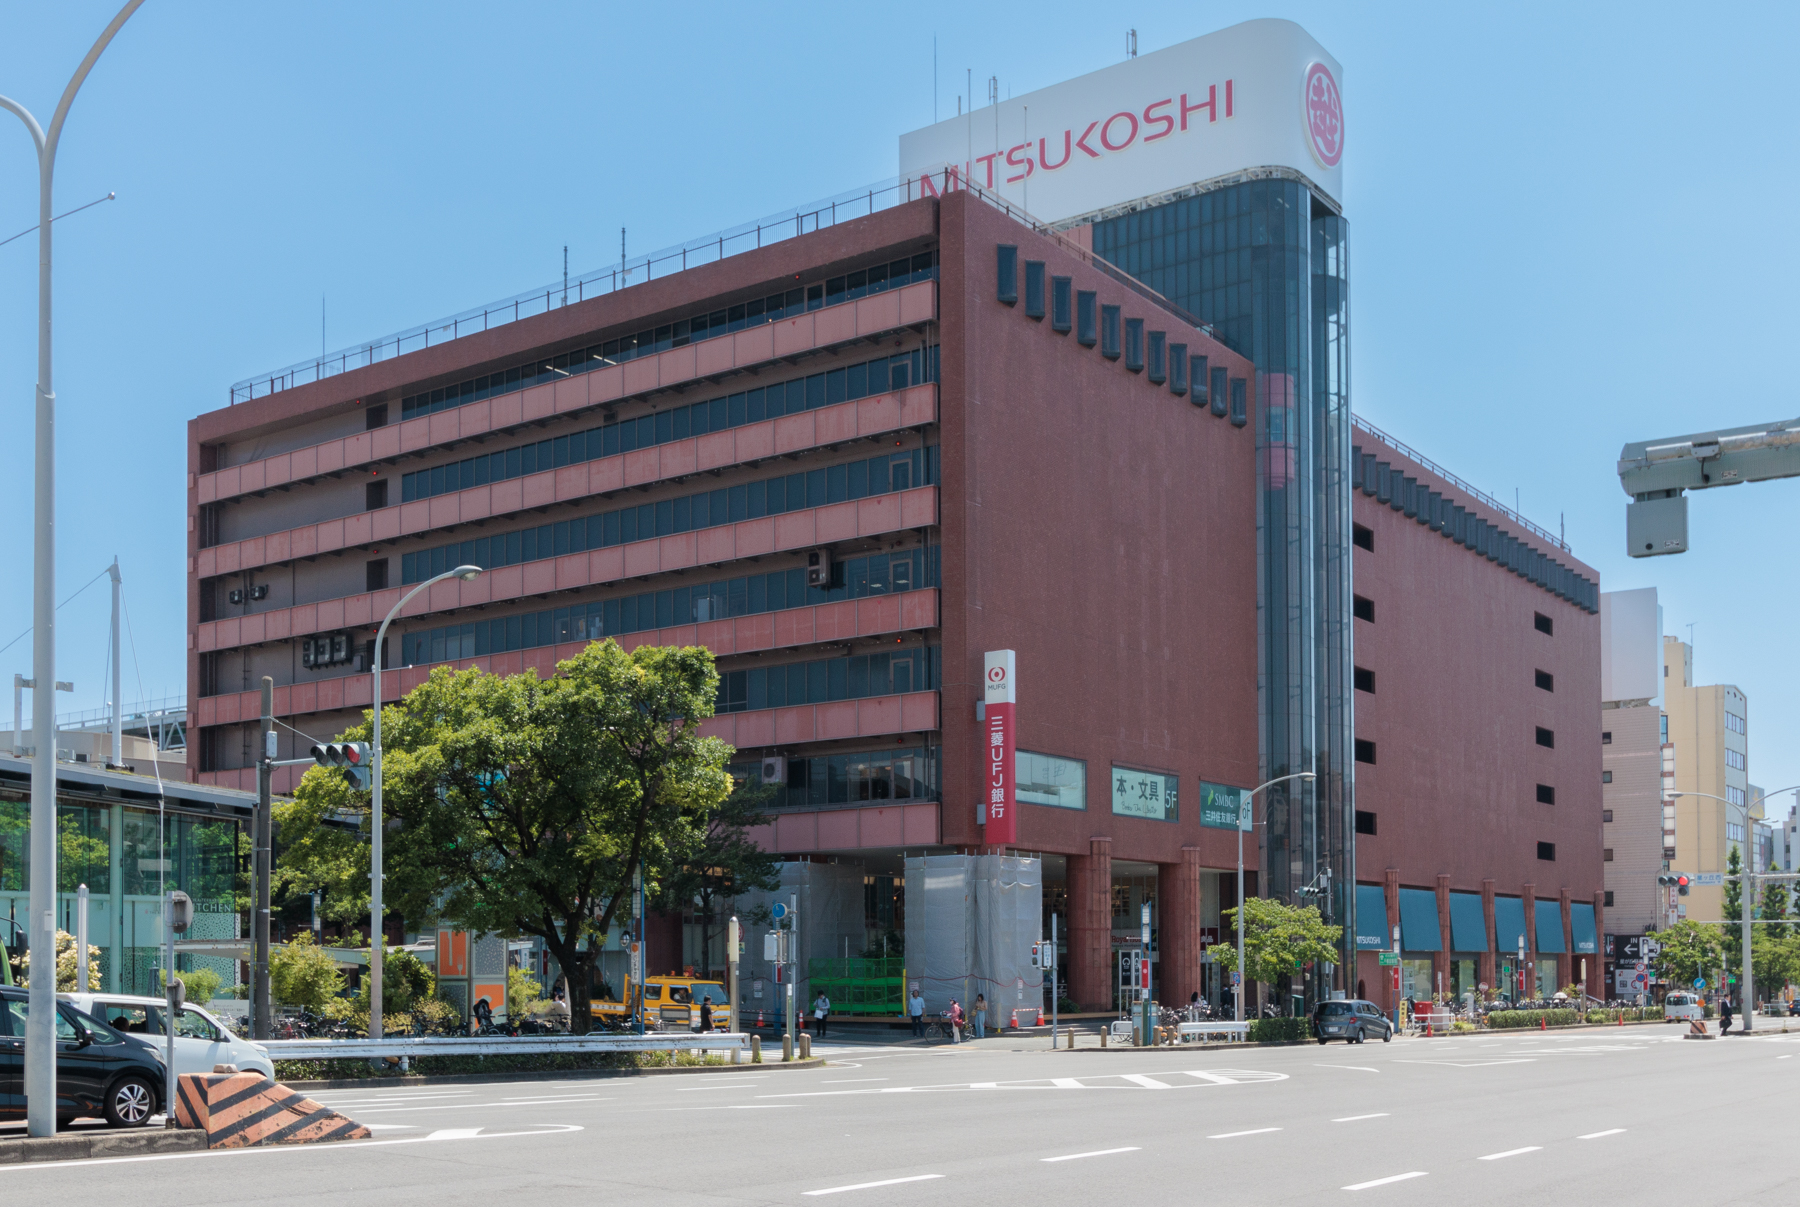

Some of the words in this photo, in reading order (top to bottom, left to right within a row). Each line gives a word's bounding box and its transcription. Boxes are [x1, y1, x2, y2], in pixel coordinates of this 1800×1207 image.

[920, 78, 1233, 199] MITSUKOSHI
[987, 683, 1006, 691] MUFG
[991, 716, 1004, 818] 三菱UFJ銀行
[1116, 775, 1159, 802] 本・文具
[1165, 790, 1177, 809] 5F
[1214, 794, 1234, 808] SMBC
[1205, 810, 1237, 825] 三井住友銀行
[193, 903, 231, 912] ITCHEN
